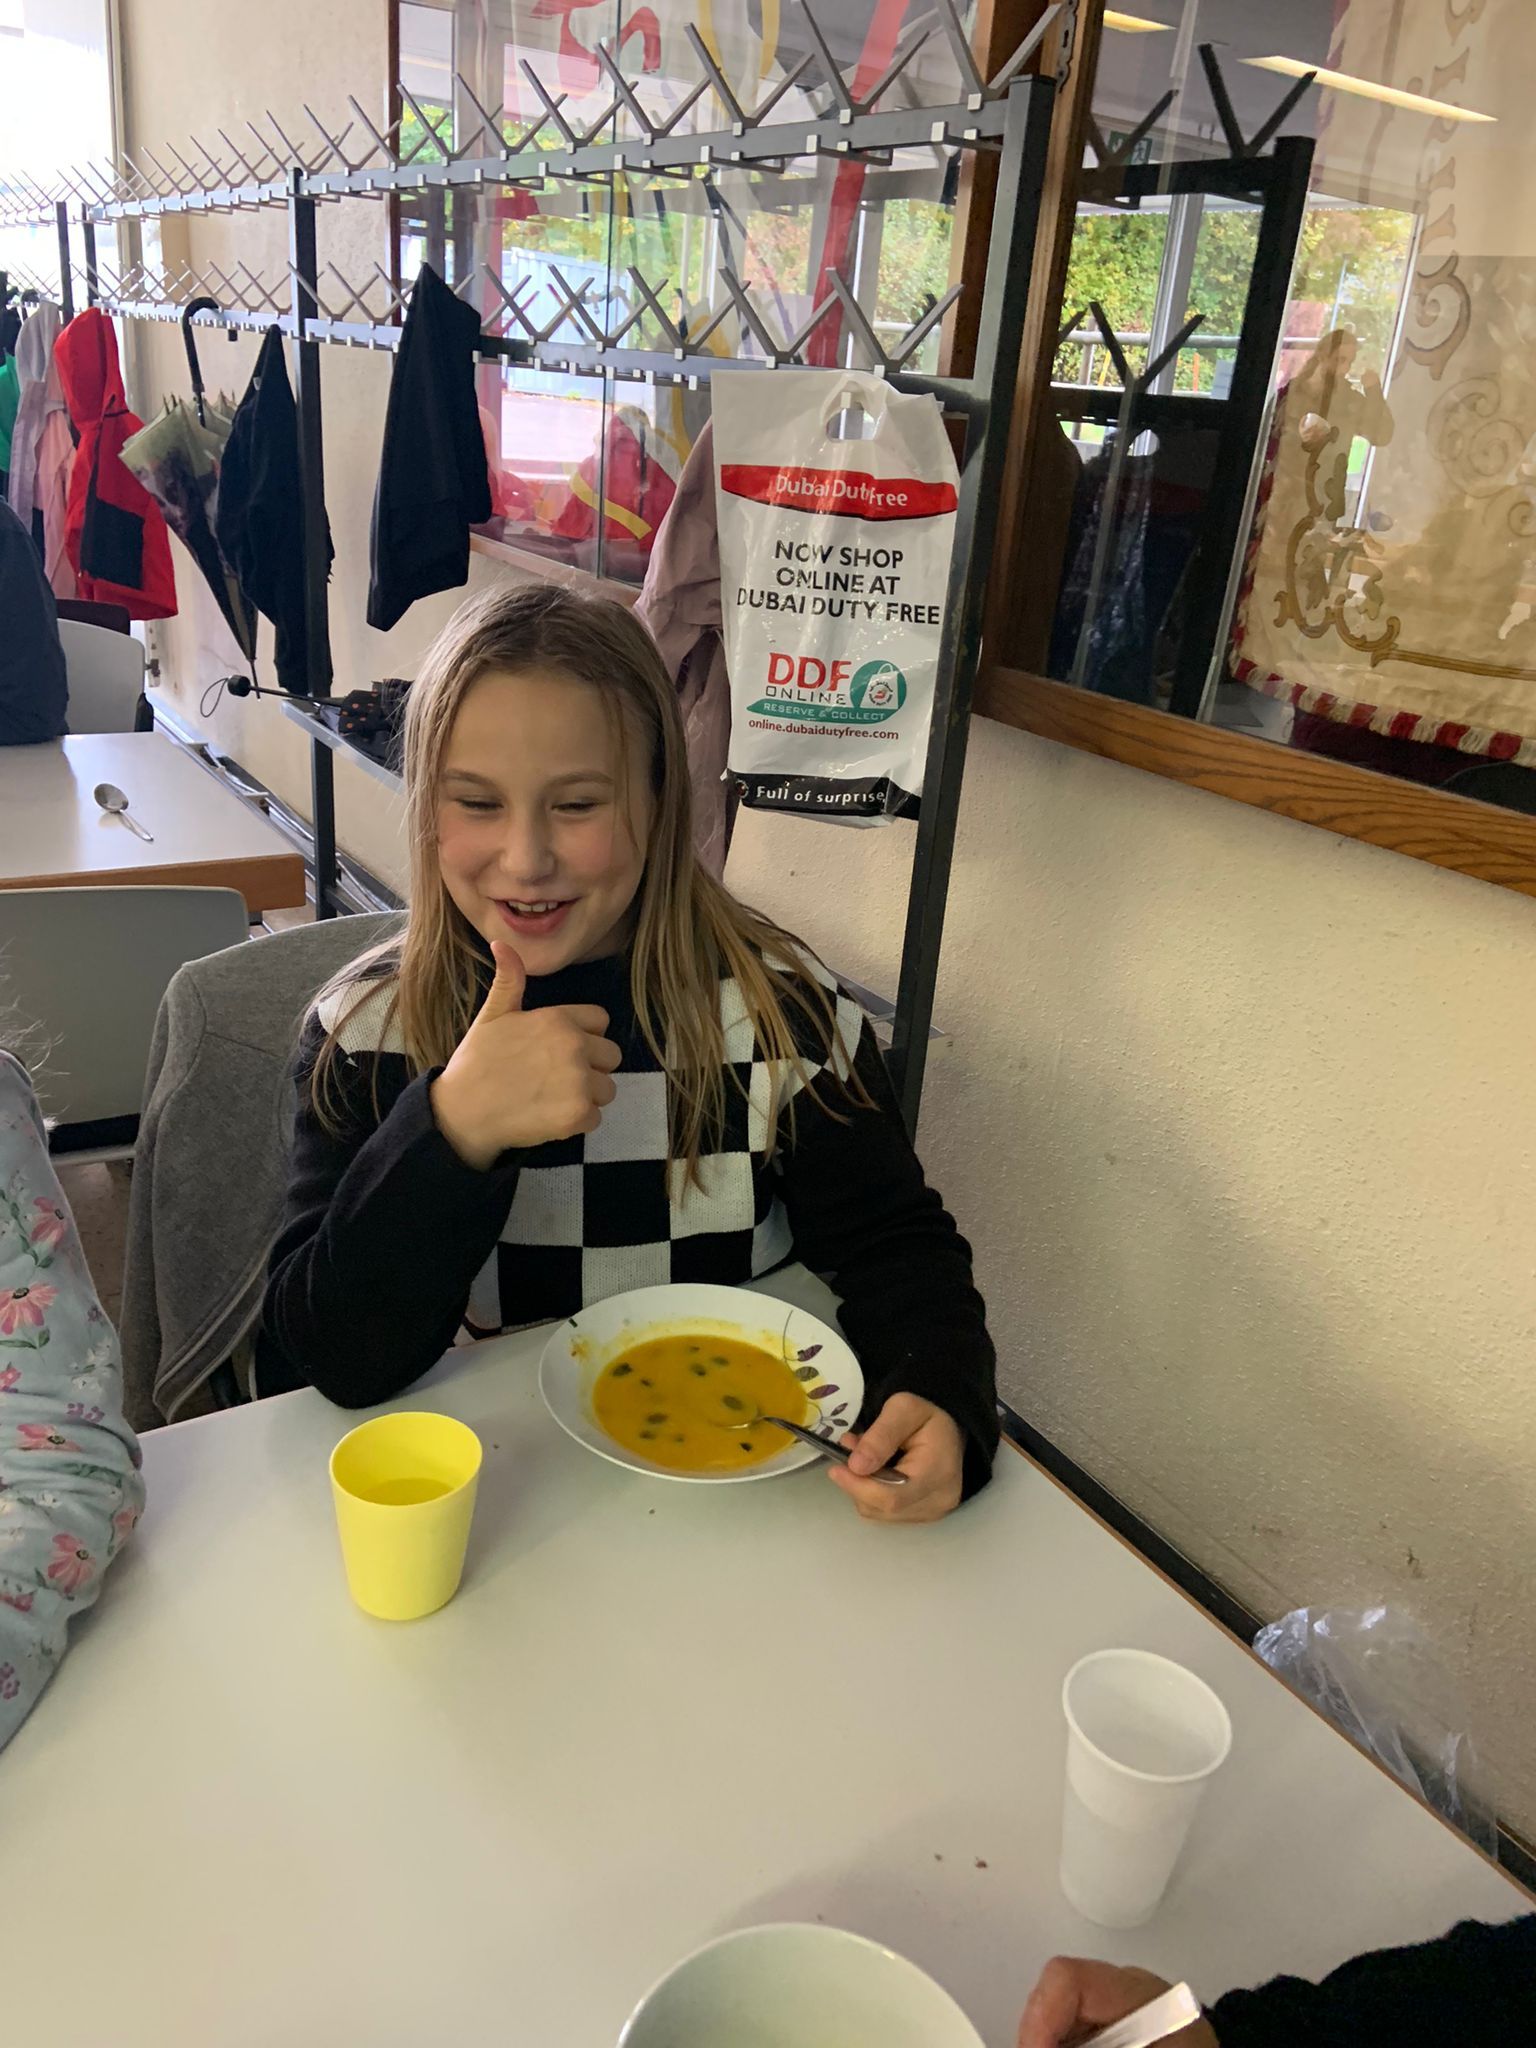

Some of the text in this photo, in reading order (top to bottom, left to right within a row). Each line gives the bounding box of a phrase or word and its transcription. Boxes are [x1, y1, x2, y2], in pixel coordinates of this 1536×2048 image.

[775, 540, 903, 569] NOW SHOP
[776, 567, 900, 595] ONLINE AT
[737, 587, 940, 625] DUBAI DUTY FREE
[767, 652, 852, 692] DDF
[765, 685, 847, 705] ONLINE
[763, 702, 886, 721] RESERVE & COLLECT
[748, 719, 899, 740] online.dubaidutyfree.com
[756, 785, 887, 806] Full of surprise
